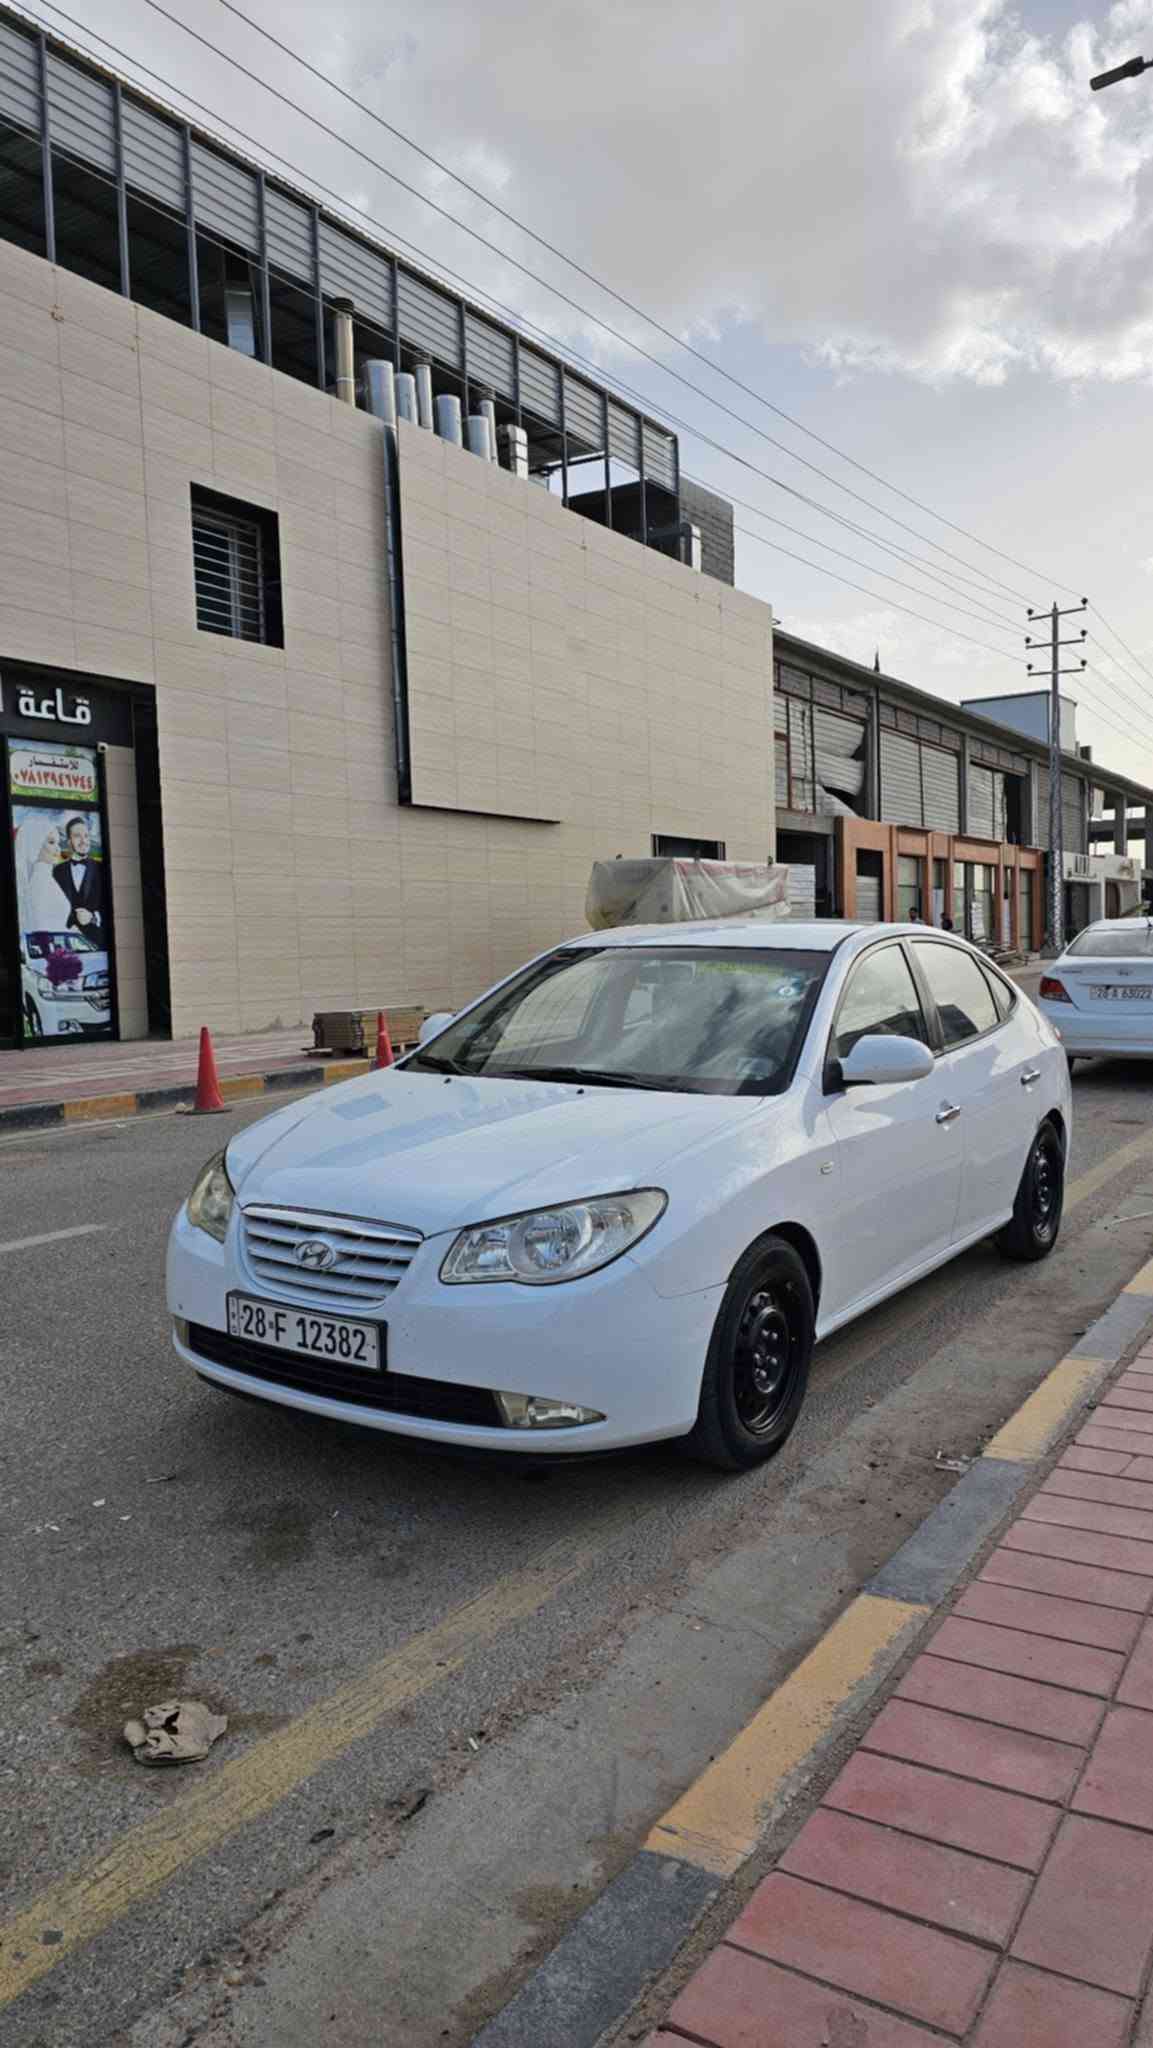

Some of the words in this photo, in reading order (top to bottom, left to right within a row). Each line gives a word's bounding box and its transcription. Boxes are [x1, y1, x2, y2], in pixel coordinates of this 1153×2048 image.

[18, 687, 92, 725] قاعة
[243, 1305, 266, 1338] 28
[274, 1312, 287, 1342] F
[296, 1317, 367, 1361] 12382
